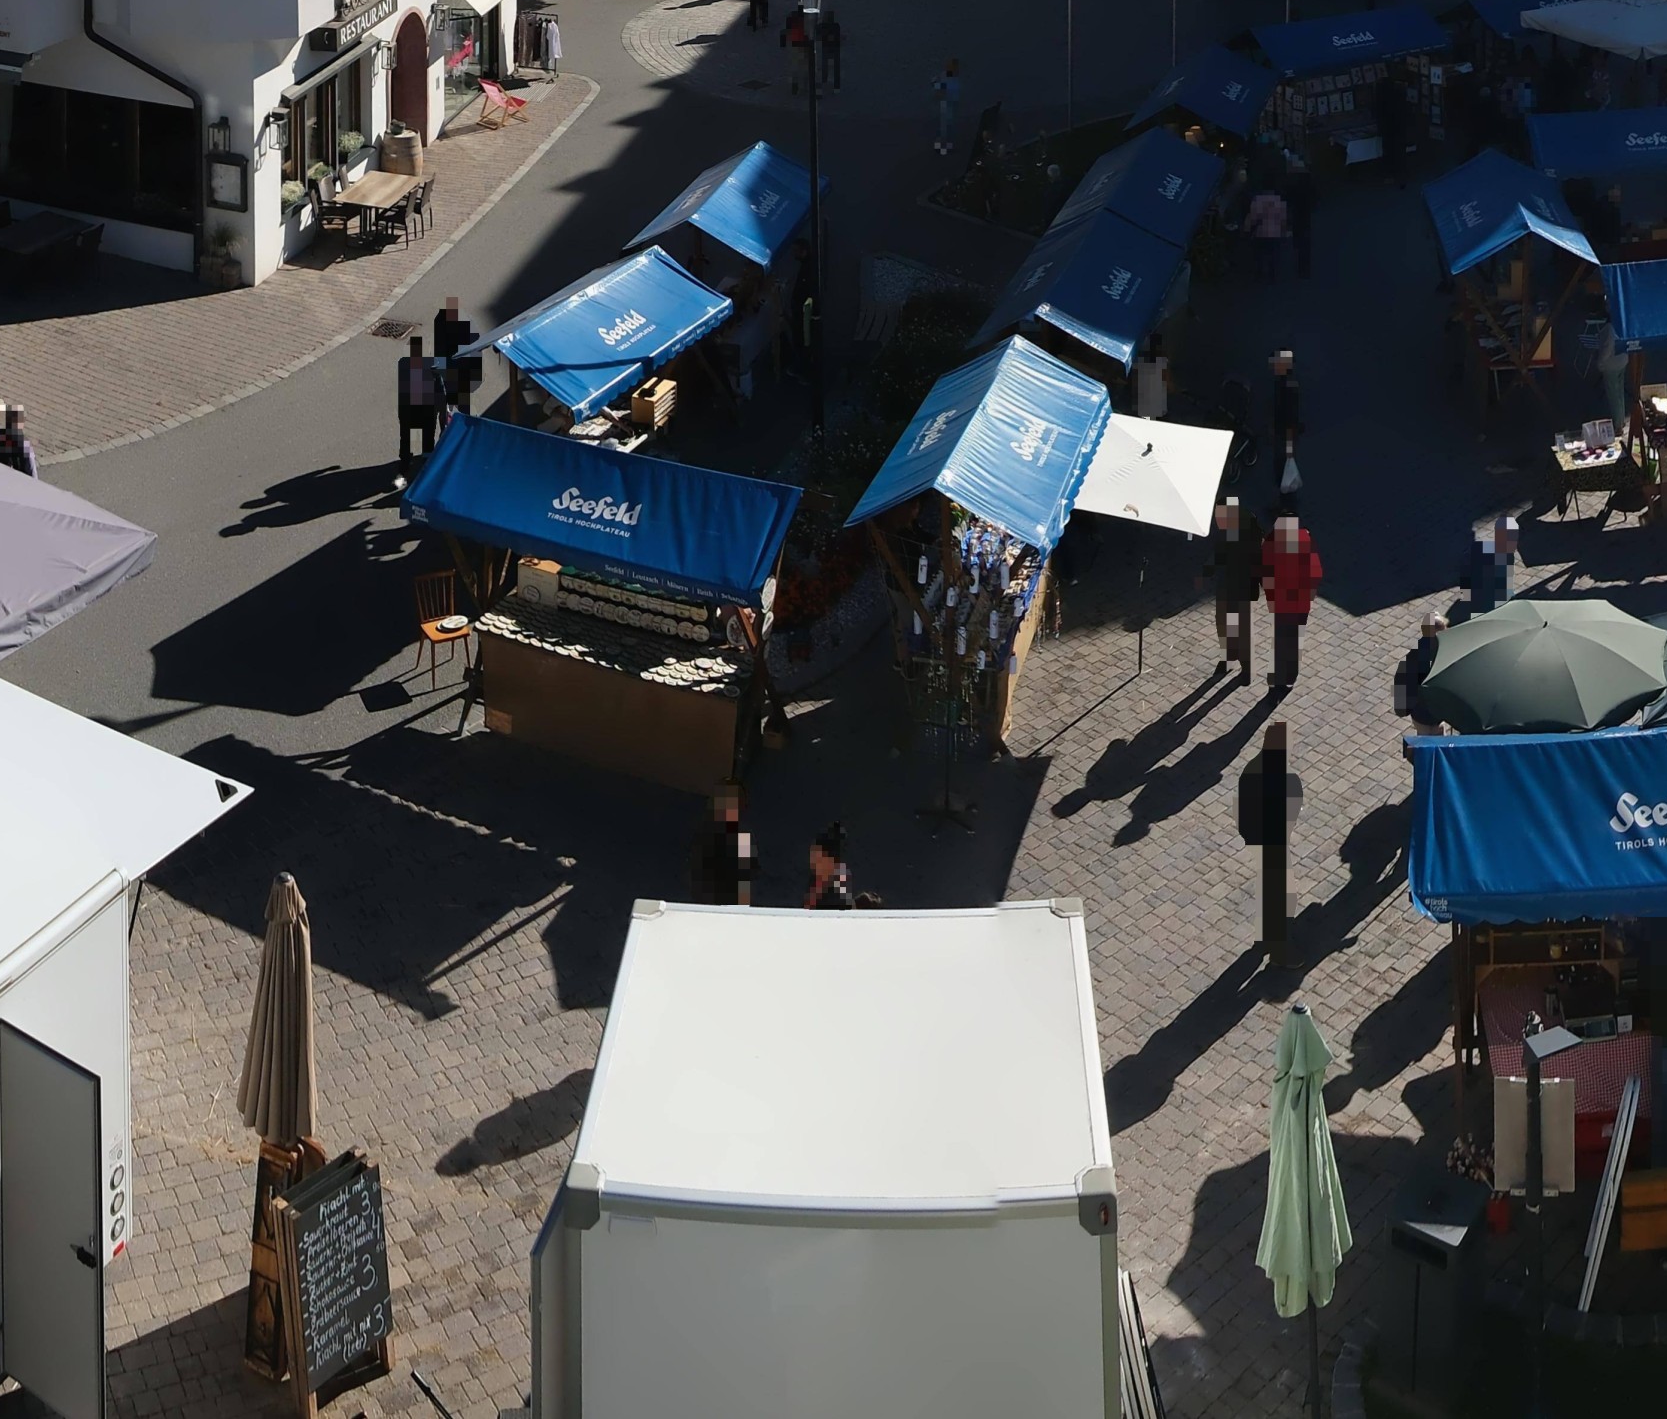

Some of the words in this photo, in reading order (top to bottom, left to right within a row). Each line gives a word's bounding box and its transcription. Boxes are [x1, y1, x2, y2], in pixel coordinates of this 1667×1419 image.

[1332, 31, 1374, 47] Seefeld
[1157, 173, 1183, 200] Seefeld
[750, 189, 780, 218] Seefeld
[1102, 265, 1132, 300] Seefeld
[598, 309, 647, 346] Seefeld
[1010, 419, 1046, 461] Seefeld
[552, 486, 643, 526] Seefeld
[547, 512, 573, 524] TIROLS
[575, 519, 631, 538] HOCHPLATEAU
[1615, 837, 1655, 851] TIROLS
